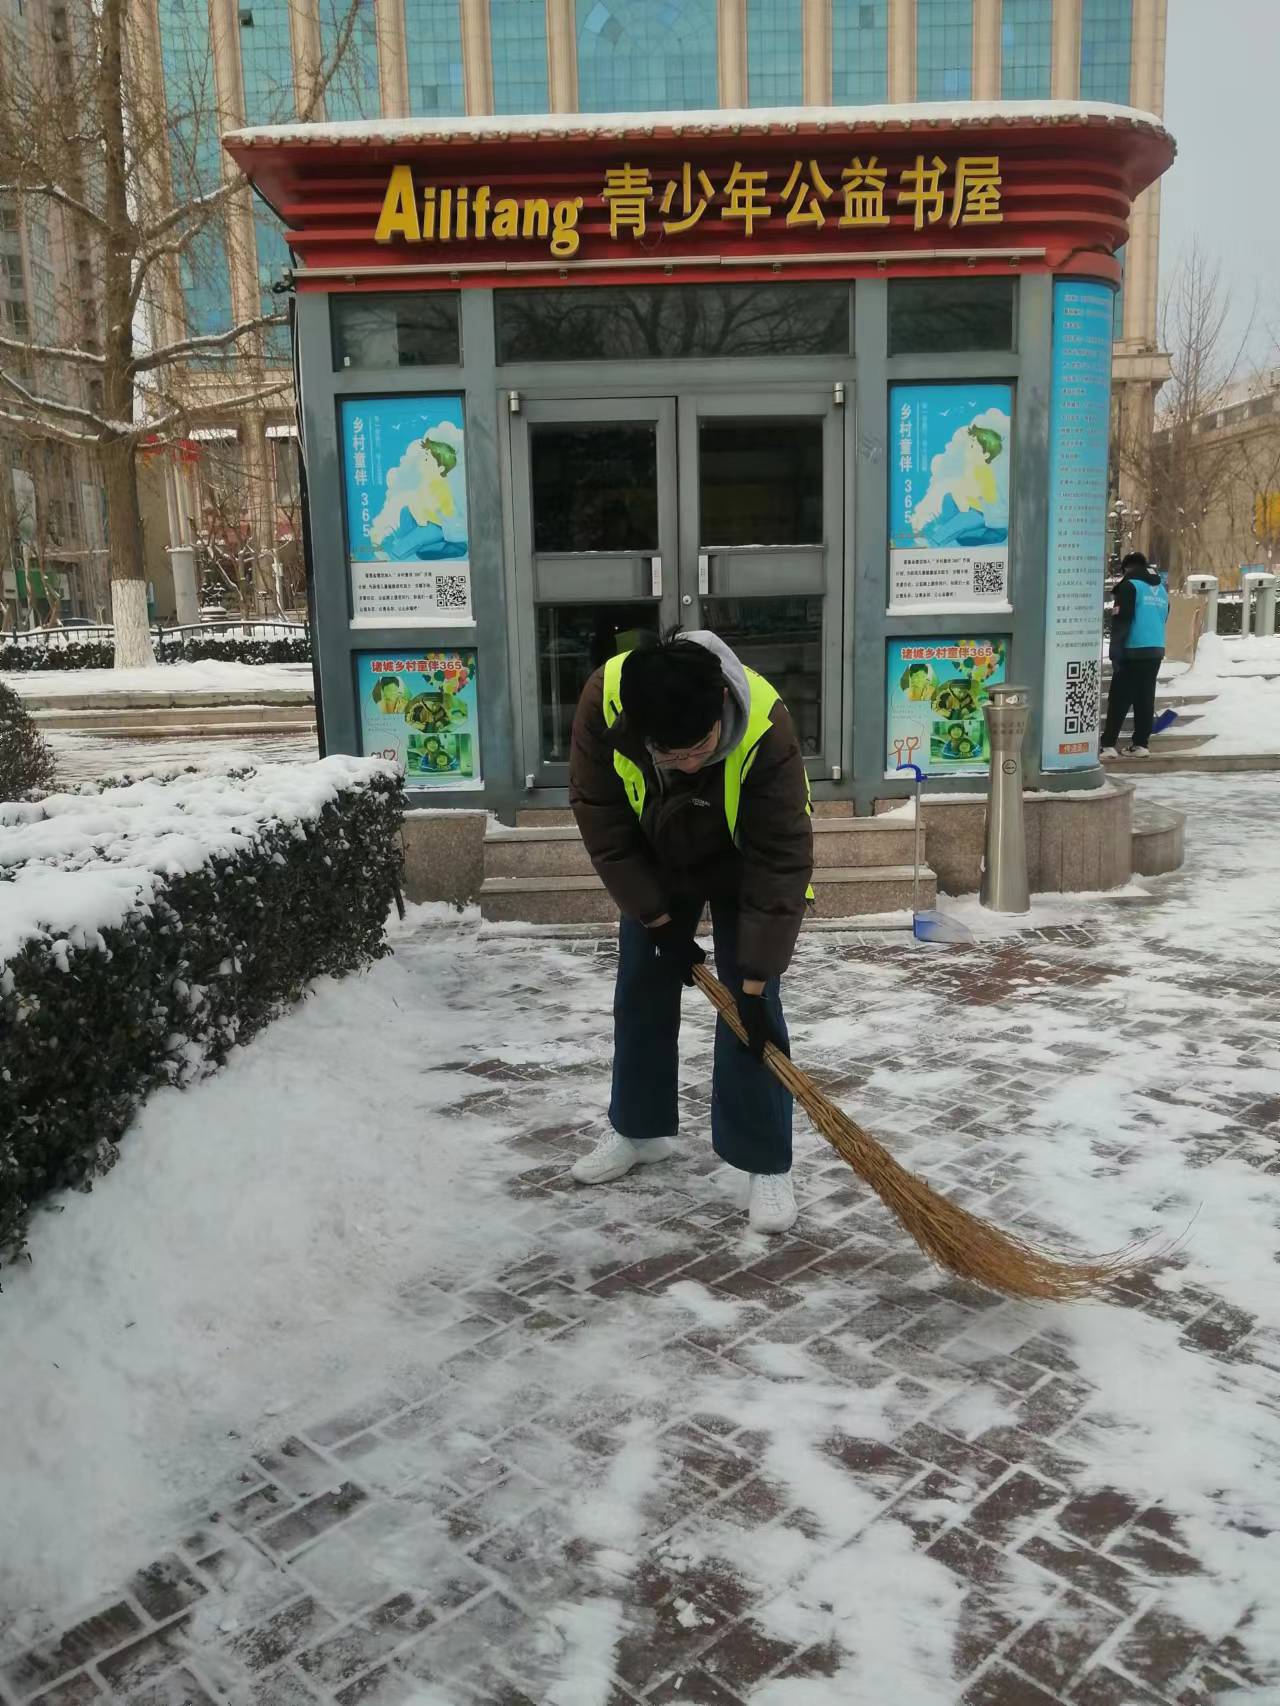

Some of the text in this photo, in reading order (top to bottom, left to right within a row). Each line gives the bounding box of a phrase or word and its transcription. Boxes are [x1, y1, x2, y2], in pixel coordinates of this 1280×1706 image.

[374, 155, 1003, 258] Ailifang 青少年公益书屋
